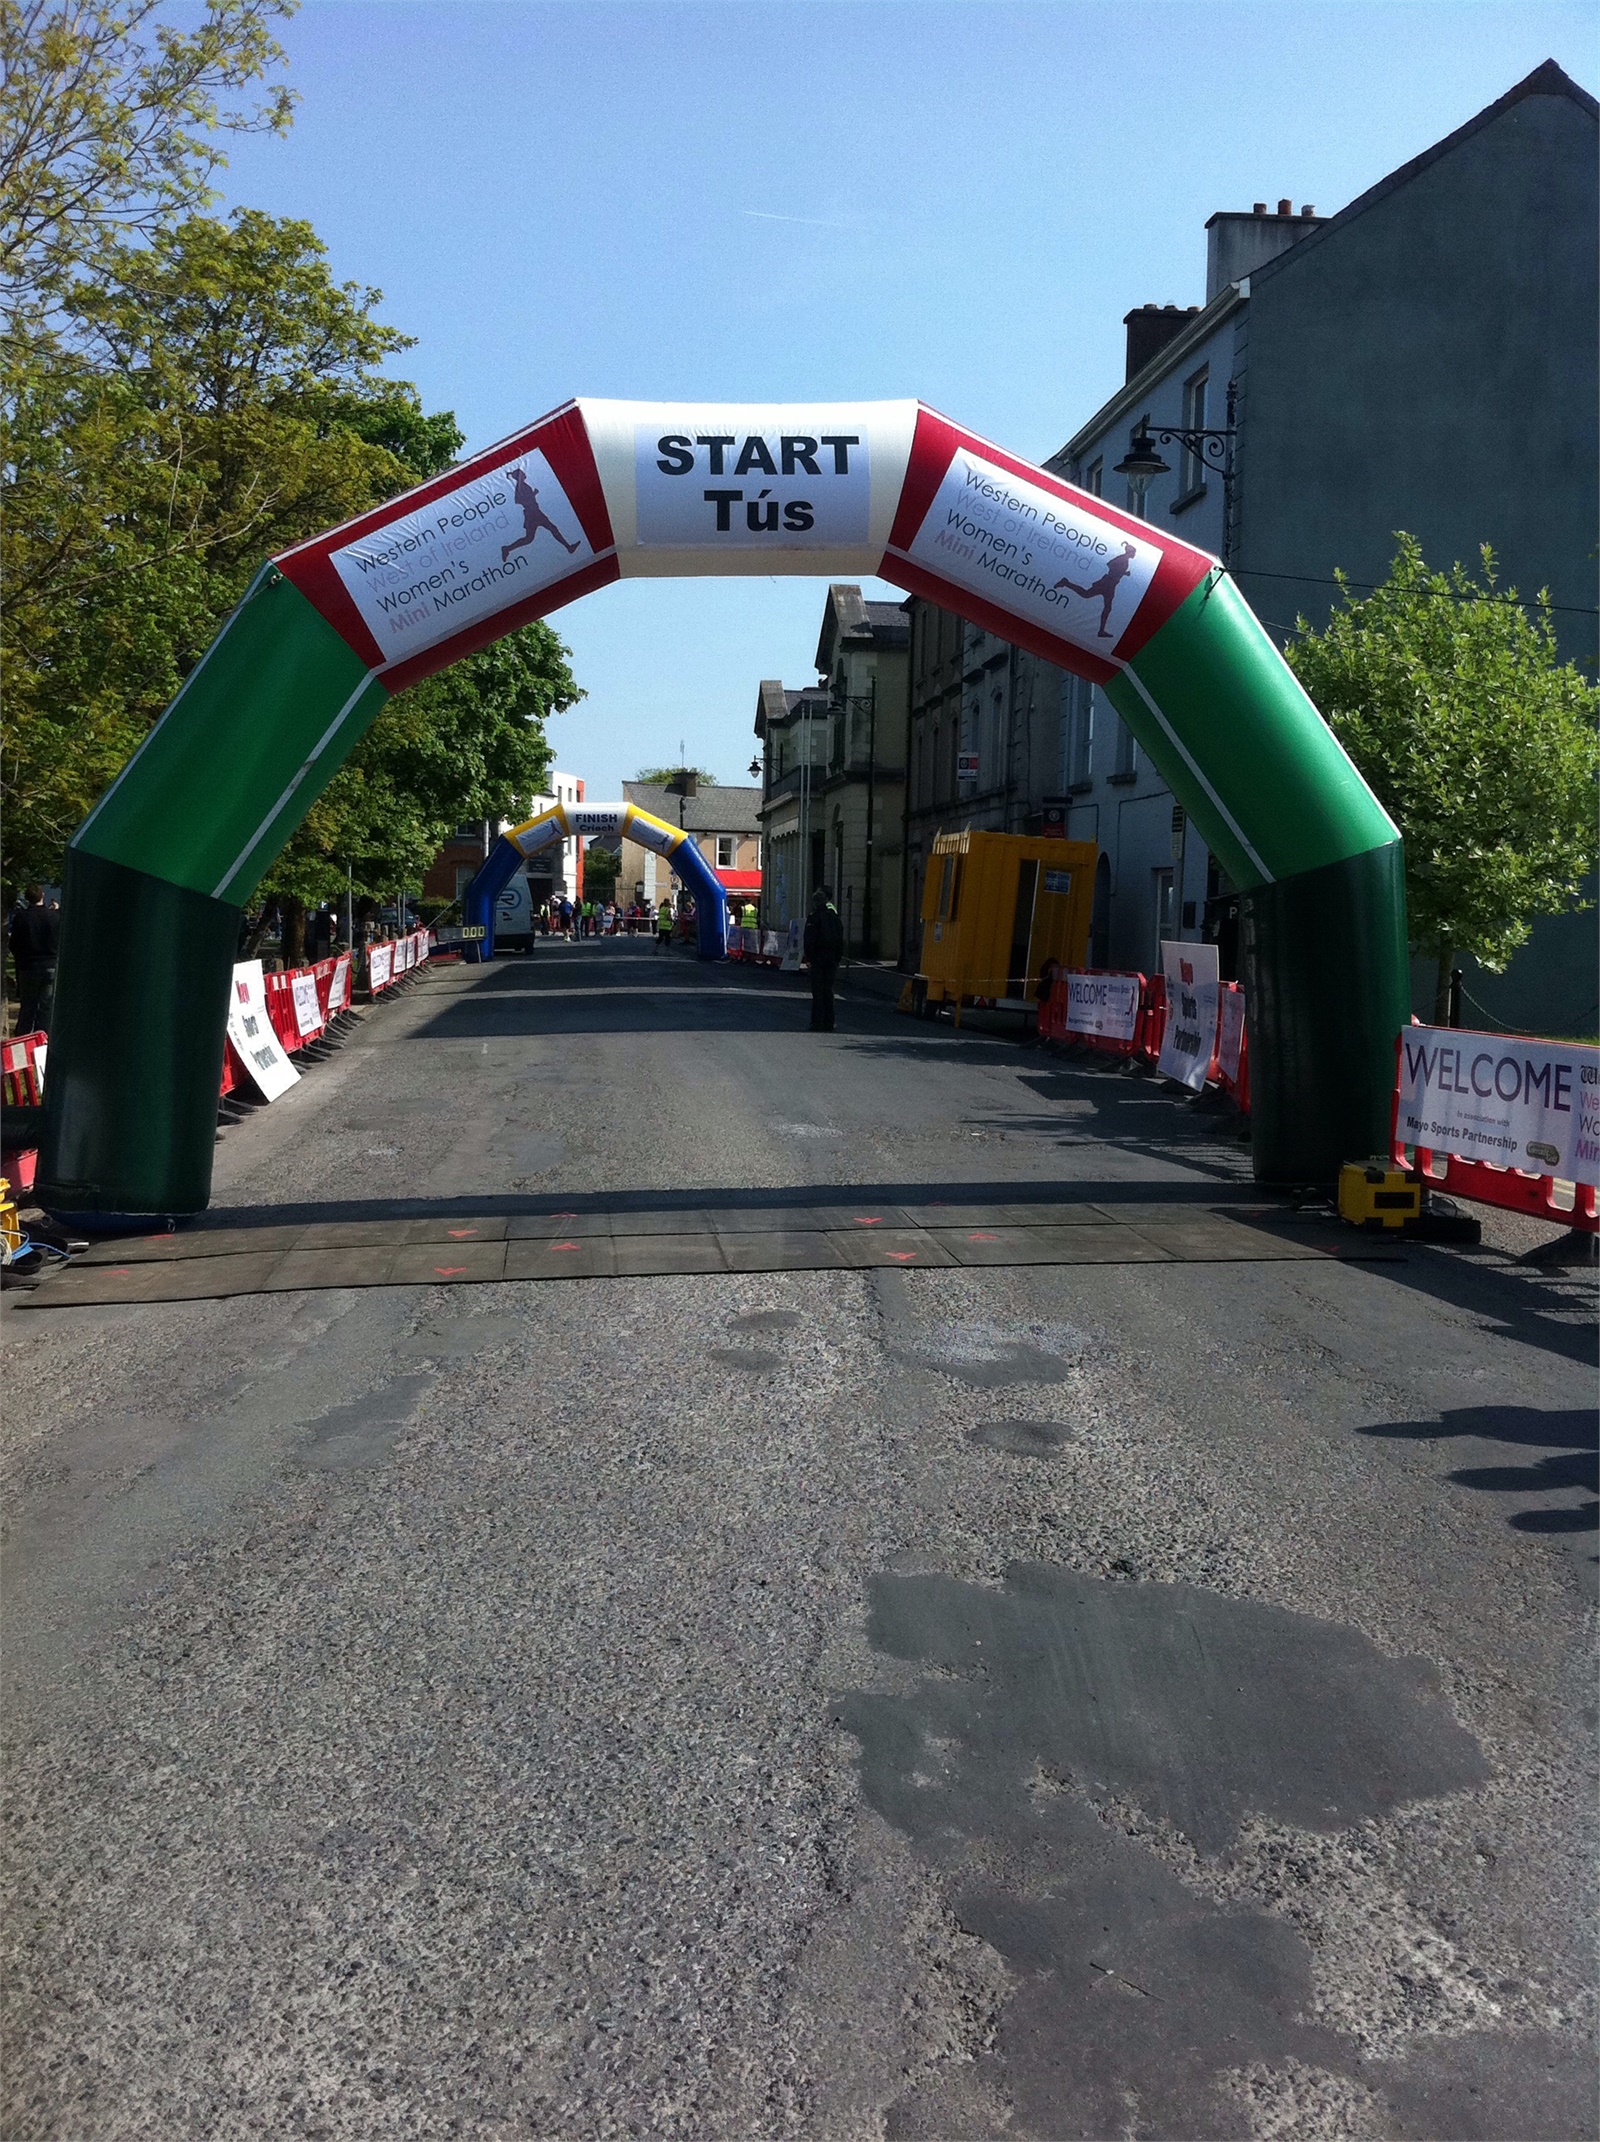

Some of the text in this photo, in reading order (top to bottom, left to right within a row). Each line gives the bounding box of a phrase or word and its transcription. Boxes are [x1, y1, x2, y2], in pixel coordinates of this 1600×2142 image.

[657, 435, 860, 475] START
[356, 491, 507, 574] Western People
[704, 489, 815, 531] Tús
[947, 509, 1033, 567] Women's
[956, 488, 1094, 571] West of Ireland
[965, 471, 1108, 556] Western People
[366, 510, 511, 593] West of Ireland
[933, 528, 1071, 609] Mini Marathon
[375, 559, 470, 614] Women's
[388, 553, 529, 634] Mini Marathon
[575, 813, 618, 823] FINISH
[1229, 906, 1238, 919] P
[1069, 982, 1107, 1006] WELCOME
[1405, 1043, 1572, 1112] WELCOME
[1406, 1116, 1518, 1152] Mayo Sports Partnership
